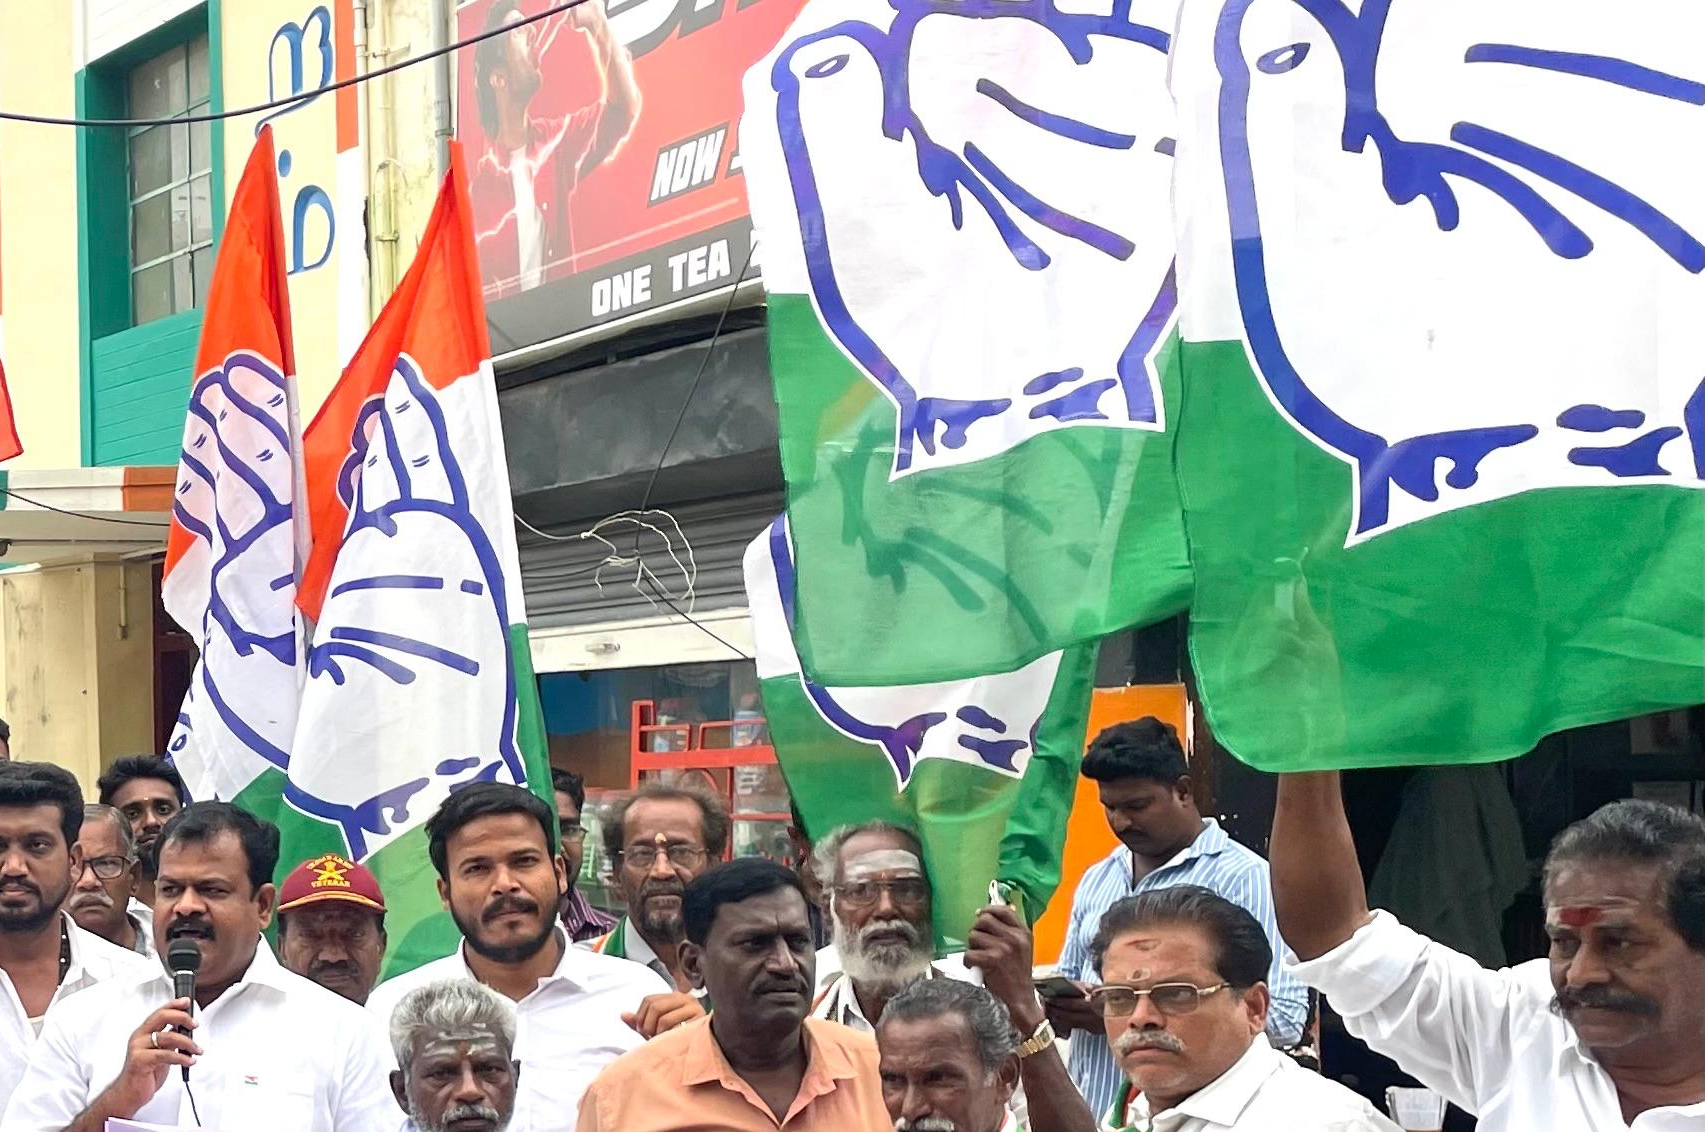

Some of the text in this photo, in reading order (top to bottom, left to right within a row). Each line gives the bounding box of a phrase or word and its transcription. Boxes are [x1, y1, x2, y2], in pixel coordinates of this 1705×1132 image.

[650, 127, 727, 201] NOW
[591, 263, 653, 317] ONE
[668, 238, 732, 293] TEA
